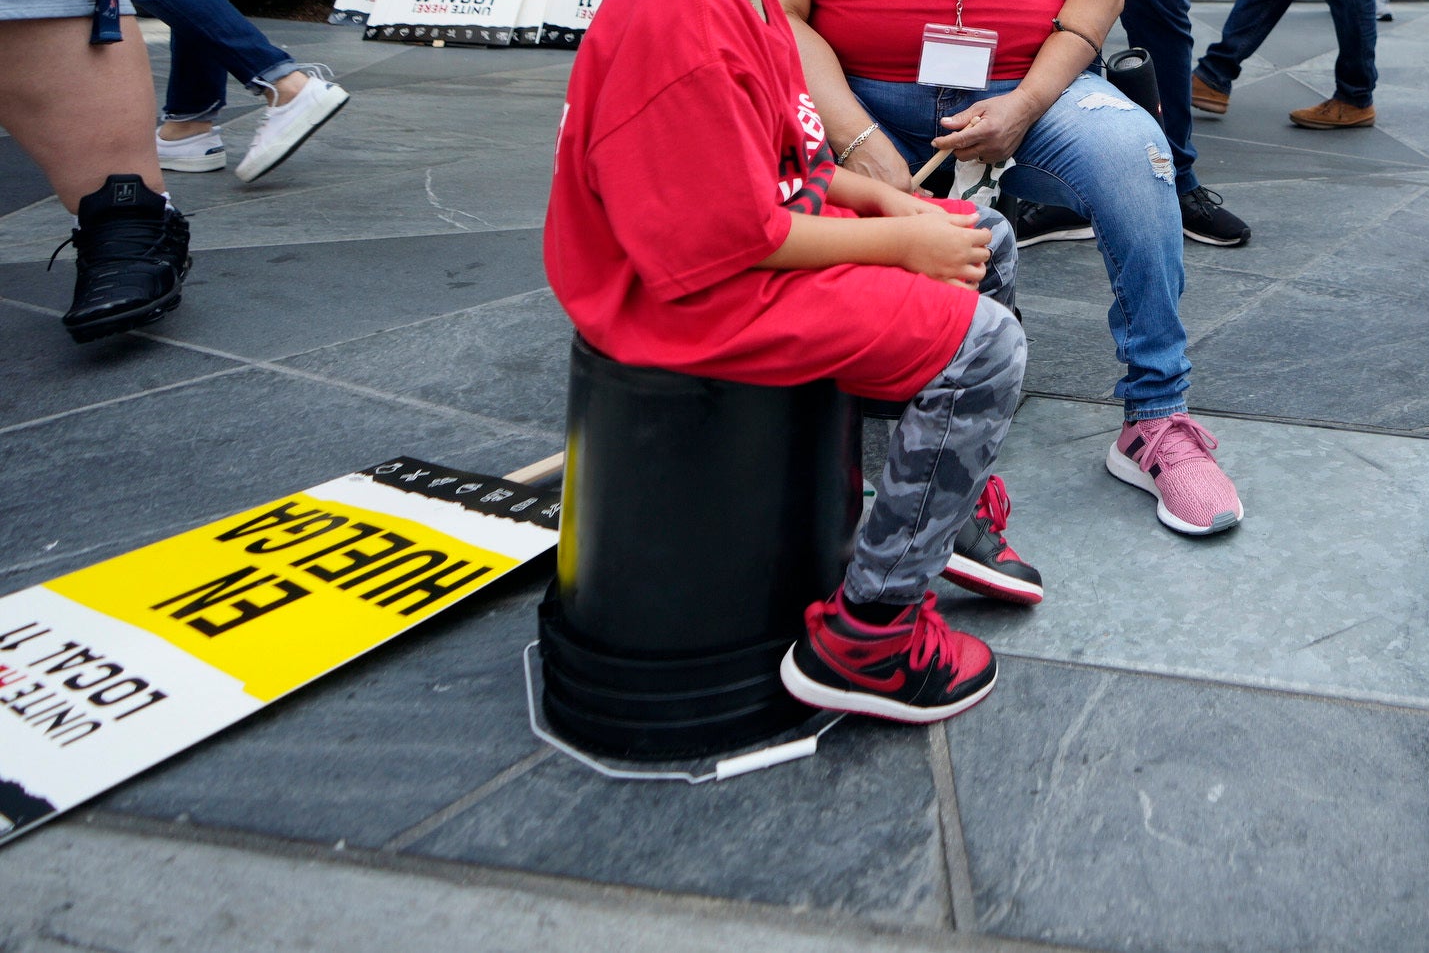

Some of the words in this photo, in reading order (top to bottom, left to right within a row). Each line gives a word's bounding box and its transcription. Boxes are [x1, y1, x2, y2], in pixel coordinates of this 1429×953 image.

[450, 4, 492, 17] UNITE
[214, 501, 495, 616] HUELGA
[150, 565, 314, 638] EN
[0, 683, 102, 747] UNITE
[30, 641, 168, 723] LOCAL
